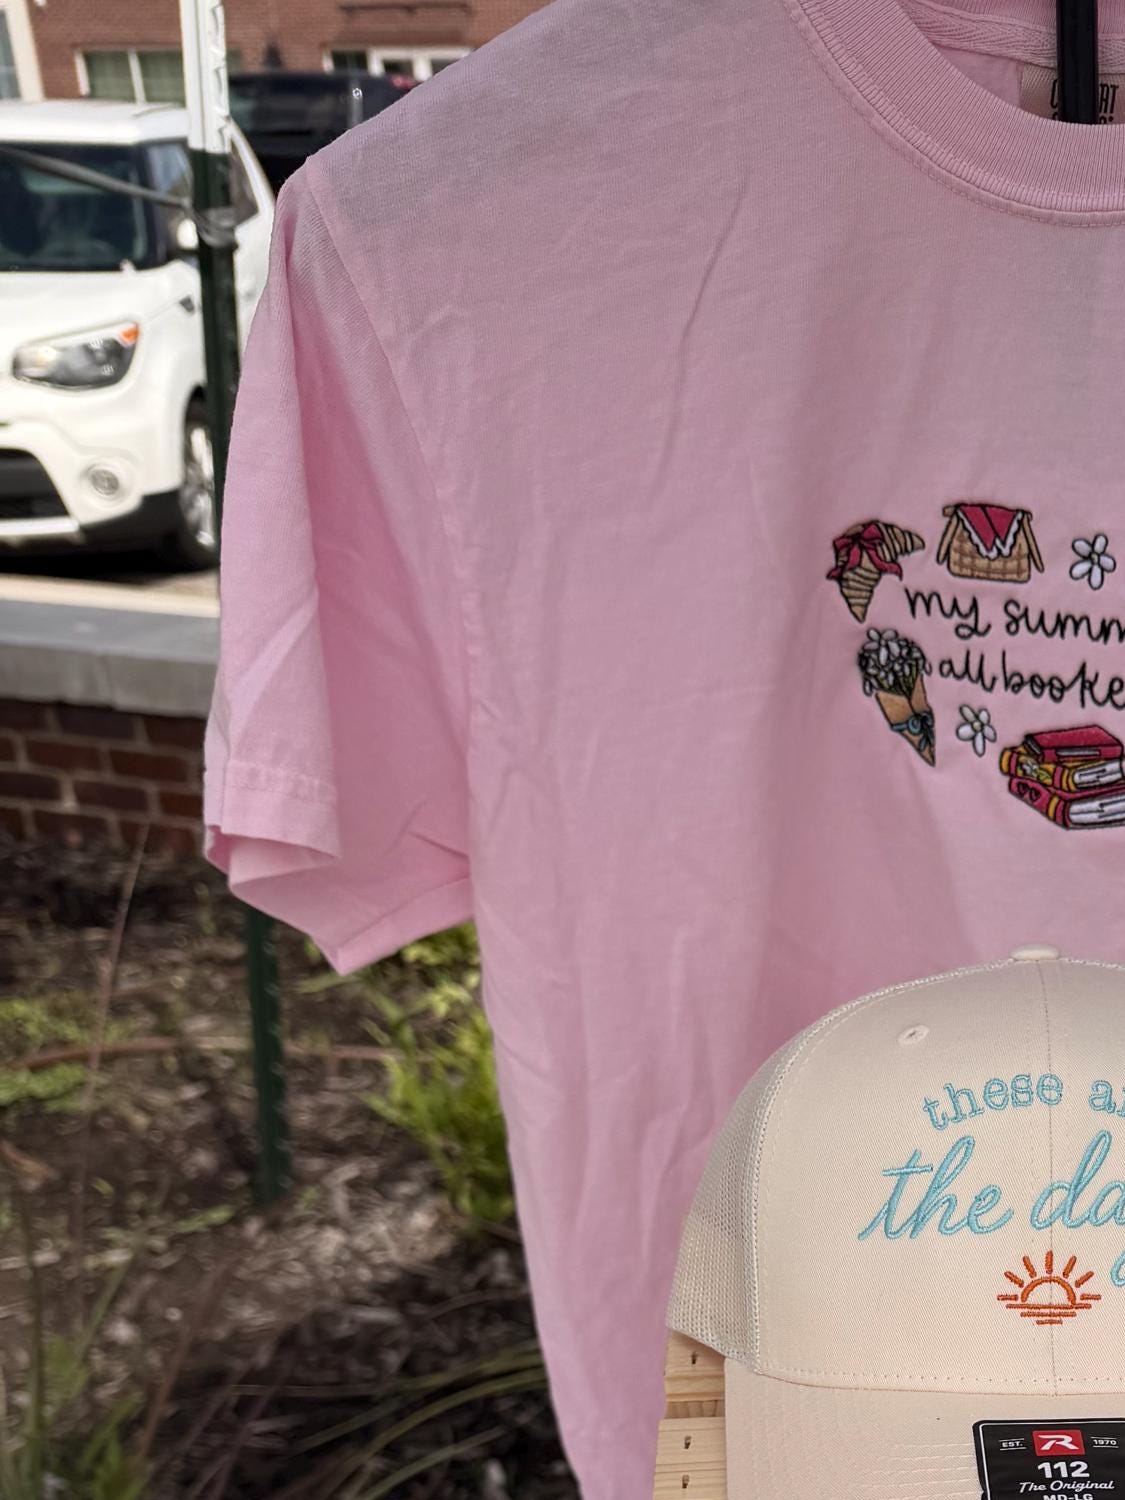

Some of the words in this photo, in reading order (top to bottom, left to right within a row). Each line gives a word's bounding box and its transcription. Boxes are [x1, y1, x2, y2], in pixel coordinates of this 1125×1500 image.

[904, 586, 991, 641] my
[939, 650, 998, 693] all
[923, 1072, 1065, 1131] these
[857, 1134, 1015, 1241] the
[1002, 1440, 1024, 1448] EST.
[1092, 1438, 1117, 1446] 1970
[1019, 1481, 1047, 1494] The
[1050, 1480, 1115, 1493] Original
[1037, 1460, 1090, 1479] 112
